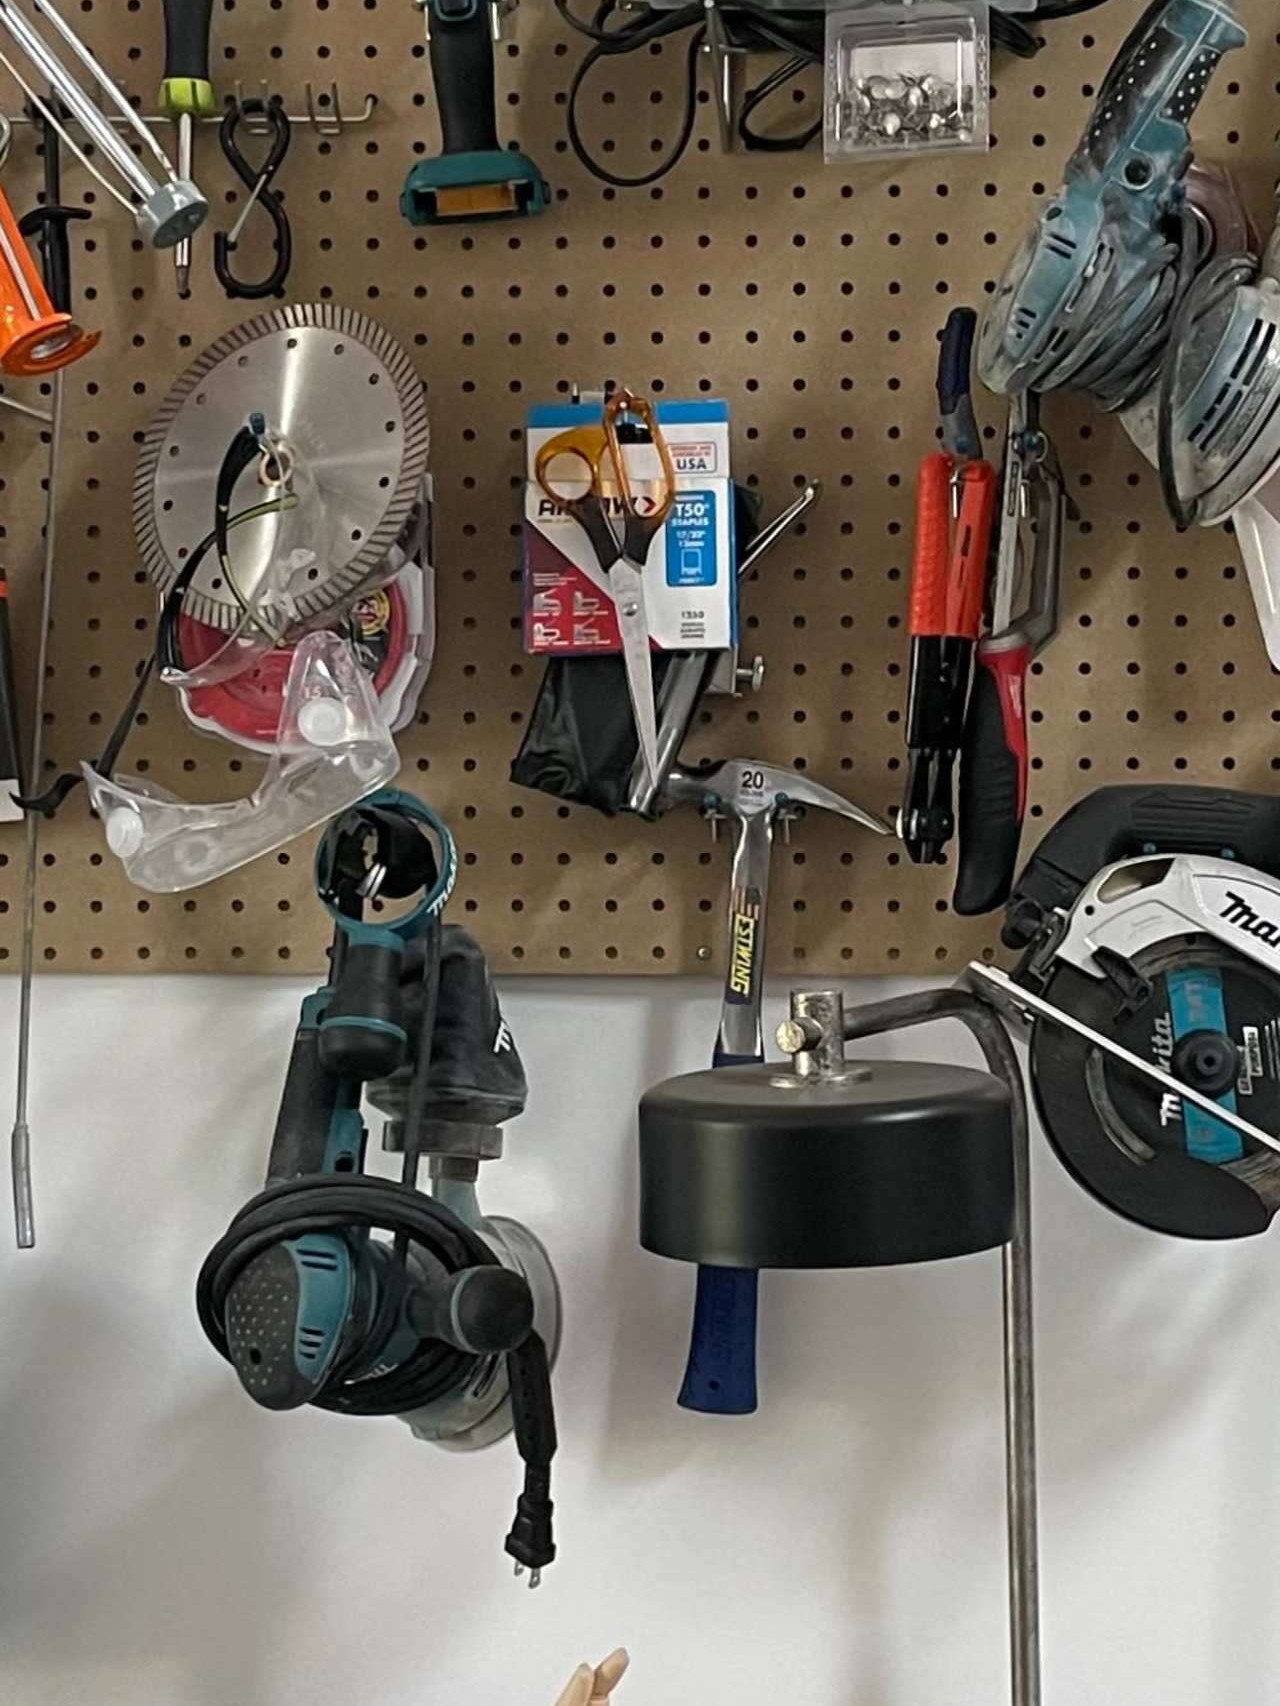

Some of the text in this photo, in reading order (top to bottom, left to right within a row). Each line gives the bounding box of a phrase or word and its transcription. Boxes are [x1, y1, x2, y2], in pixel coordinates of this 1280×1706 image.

[676, 458, 707, 470] USA
[671, 517, 709, 526] STAPLES
[741, 771, 764, 789] 20
[730, 913, 755, 996] ESTWING
